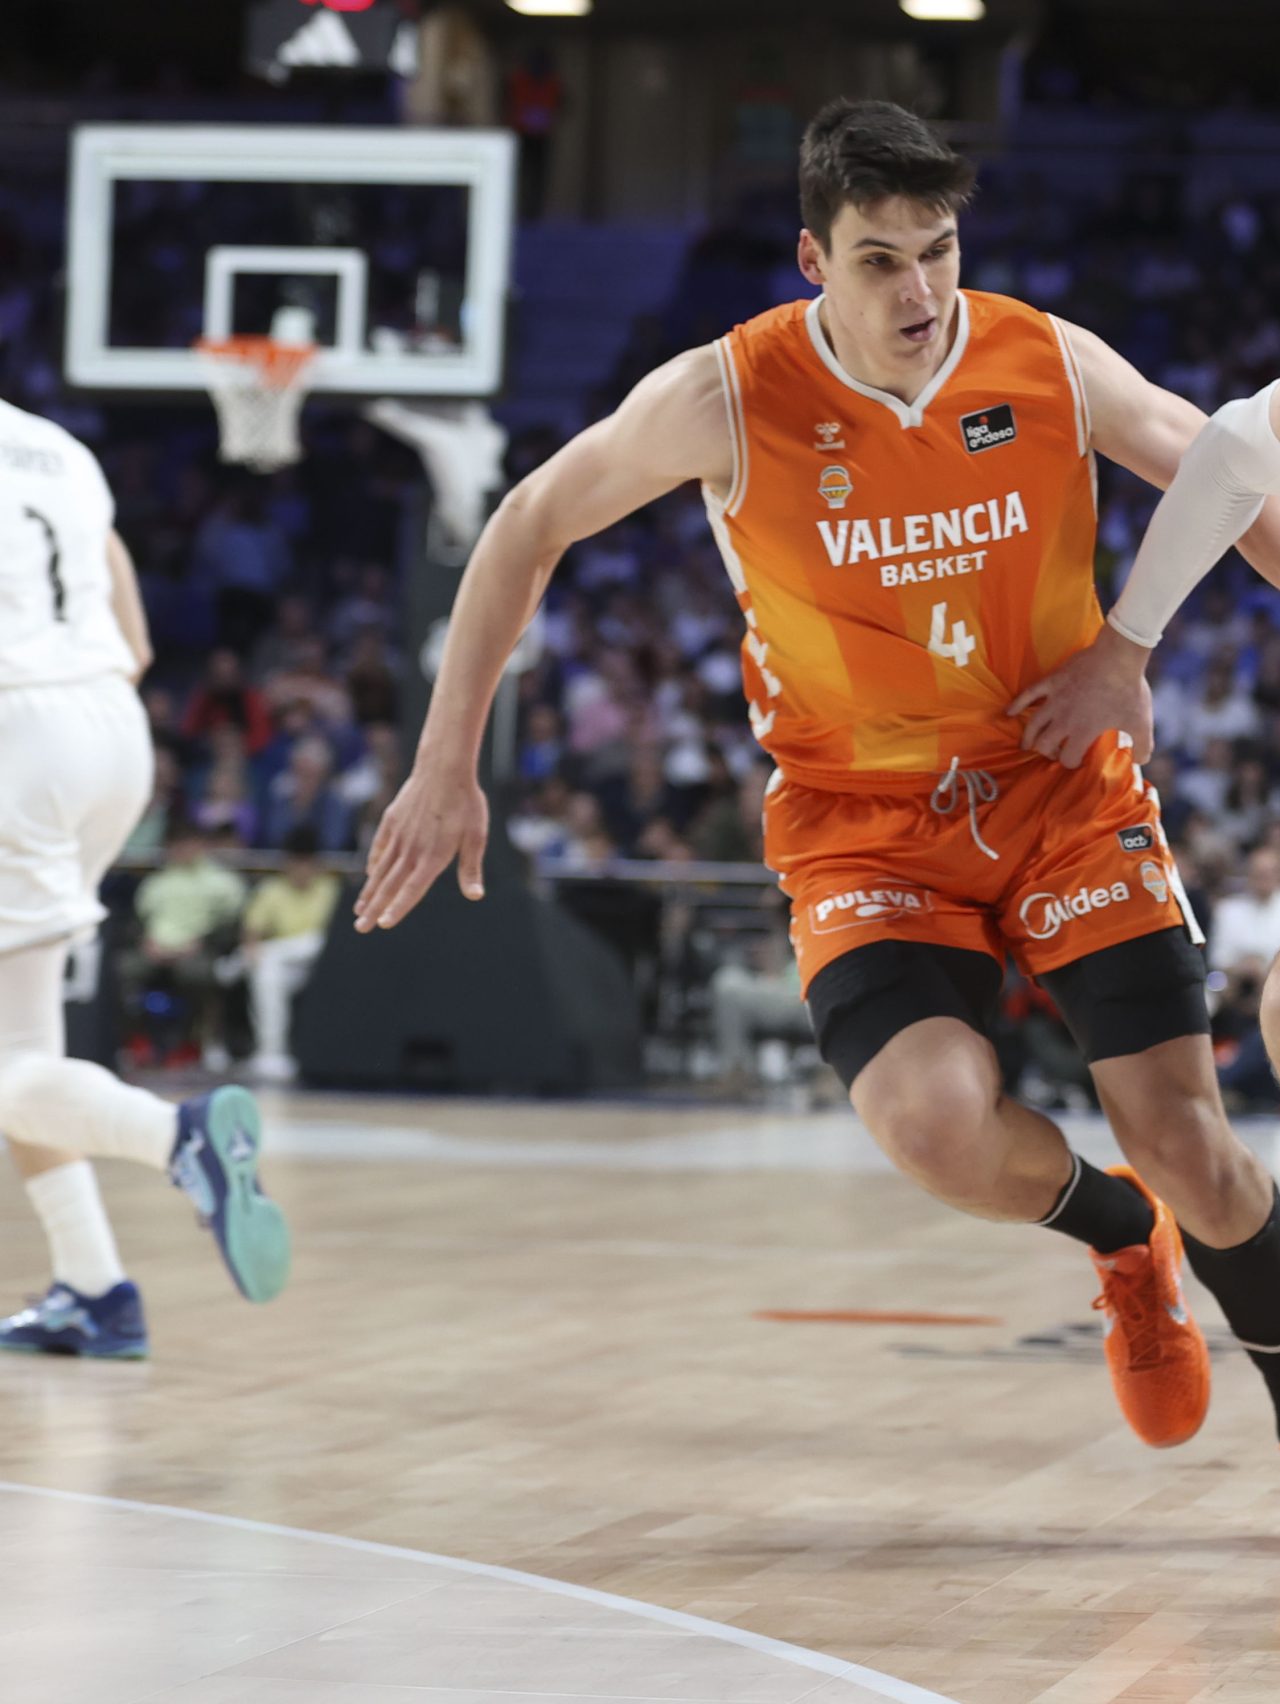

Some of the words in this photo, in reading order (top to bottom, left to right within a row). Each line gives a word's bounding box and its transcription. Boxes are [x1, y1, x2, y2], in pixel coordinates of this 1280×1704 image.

[816, 491, 1029, 566] VALENCIA
[880, 549, 989, 587] BASKET
[928, 601, 976, 668] 4
[1123, 835, 1148, 849] acb
[815, 889, 921, 922] PULEVA
[1019, 882, 1130, 939] Midea
